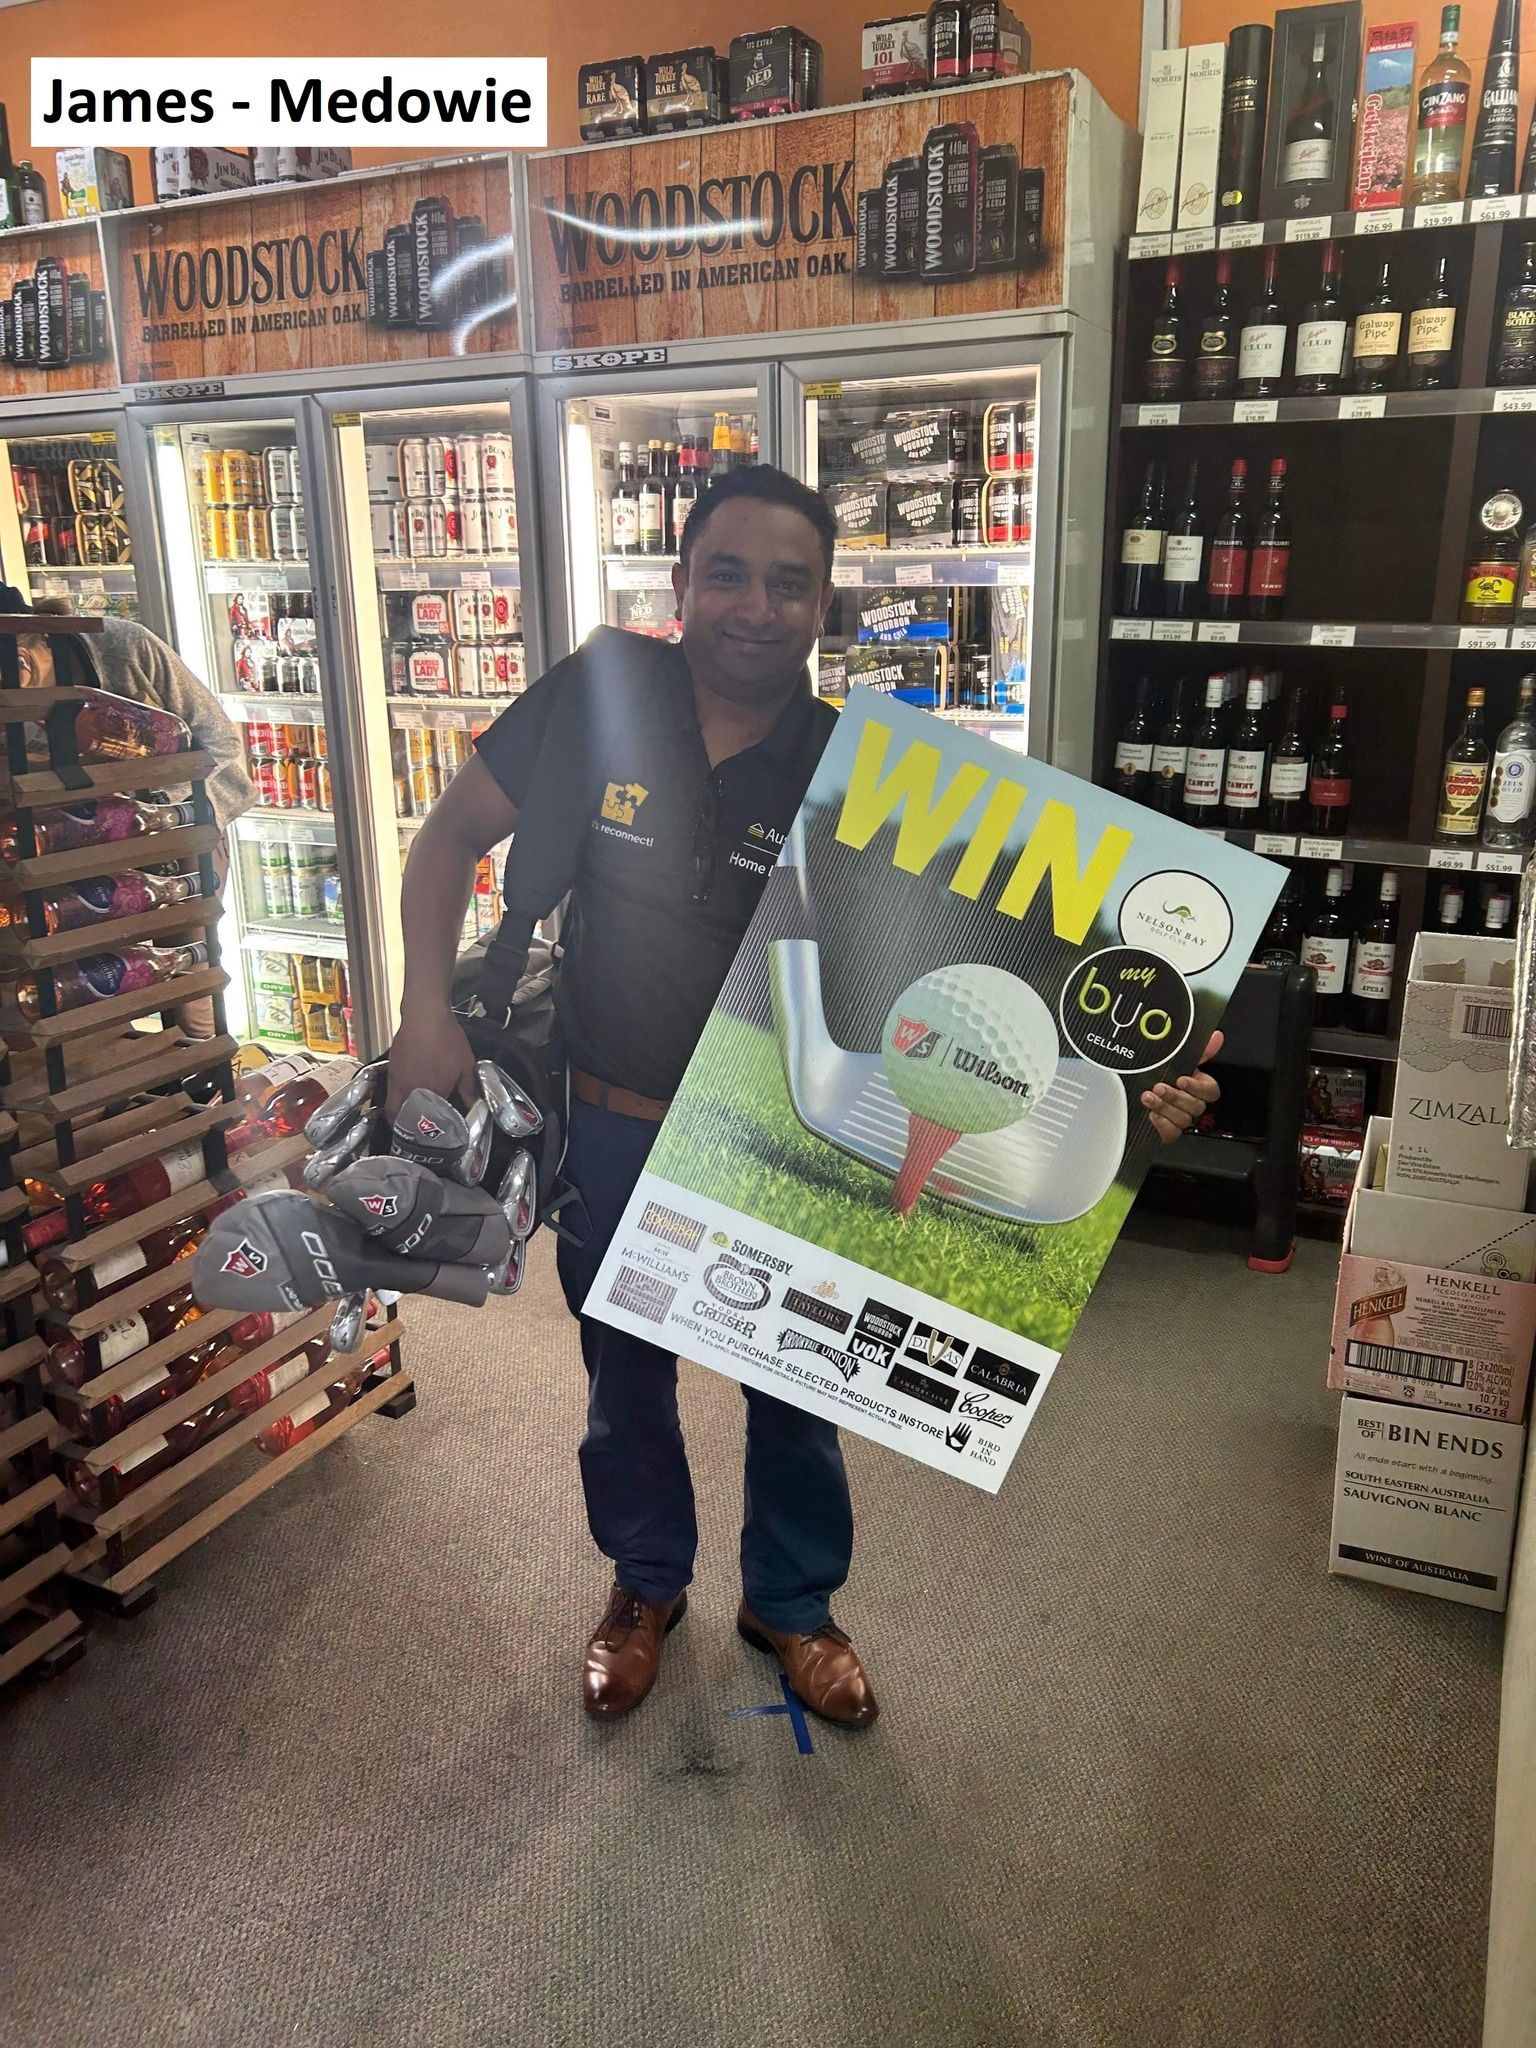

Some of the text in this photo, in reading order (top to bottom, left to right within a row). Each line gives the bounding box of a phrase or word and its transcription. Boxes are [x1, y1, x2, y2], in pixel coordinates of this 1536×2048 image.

[872, 41, 895, 51] TURKEY
[876, 33, 893, 42] WILD
[874, 51, 893, 65] 101
[746, 69, 772, 87] NED
[586, 93, 606, 104] RARE
[655, 84, 676, 96] RARE
[1422, 92, 1466, 109] CINZANO
[1358, 94, 1383, 190] Gekkeikan
[214, 162, 229, 179] JIM
[925, 142, 945, 270] WOODSTOCK
[1480, 210, 1511, 221] $61.99
[543, 160, 856, 277] WOODSTOCK
[884, 174, 899, 270] WOODSTOCK
[1364, 222, 1393, 233] $26.99
[1424, 216, 1453, 227] $19.99
[857, 196, 868, 268] WOODSTOCK
[133, 227, 367, 318] WOODSTOCK
[416, 212, 433, 319] WOODSTOCK
[386, 240, 399, 318] WOODSTOCK
[560, 252, 852, 304] BARRELLED IN AMERICAN OAK.
[14, 290, 24, 359] WOODSTOCK
[37, 269, 51, 360] WOODSTOCK
[142, 303, 366, 344] BARRELLED IN AMERICAN OAK.
[1412, 315, 1447, 327] Galway
[1360, 320, 1395, 332] Galway
[1365, 328, 1388, 341] Pipe
[1416, 324, 1439, 336] Pipe
[553, 349, 667, 371] SKOPE
[136, 383, 224, 400] SKOPE
[1503, 402, 1532, 411] $43.99
[894, 421, 941, 448] WOODSTOCK
[903, 436, 934, 453] BOURBON
[834, 493, 878, 518] WOODSTOCK
[896, 491, 943, 516] WOODSTOCK
[906, 506, 937, 521] BOURBON
[843, 508, 872, 523] BOURBON
[417, 609, 442, 620] LADY
[631, 604, 654, 619] NED
[860, 598, 918, 627] WOODSTOCK
[873, 616, 911, 633] BOURBON
[414, 666, 439, 677] LADY
[835, 717, 1135, 946] WIN
[729, 851, 766, 875] Home
[1437, 861, 1463, 869] $49.99
[1485, 864, 1512, 872] $51.99
[1135, 910, 1208, 947] NELSON BAY
[1150, 926, 1188, 947] GOLF CLUB
[1119, 966, 1157, 989] my
[1078, 966, 1173, 1043] byo
[1085, 1031, 1136, 1060] CELLARS
[1409, 1098, 1508, 1126] ZIMZAL
[714, 1274, 759, 1301] BROTHERS
[723, 1269, 757, 1291] BROWN
[1427, 1273, 1501, 1297] HENKELL
[1433, 1287, 1467, 1297] PICCOLO
[711, 1303, 745, 1320] VODKA
[1353, 1293, 1403, 1320] HENKELL
[692, 1300, 757, 1339] CRUISER
[863, 1312, 903, 1338] WOODSTOCK
[866, 1323, 894, 1340] BOURBON
[821, 1344, 855, 1376] UNION
[1468, 1360, 1515, 1377] 8 (3x200ml)
[671, 1311, 945, 1440] WHEN YOU PURCHASE SELECTED PRODUCTS INSTORE
[970, 1364, 1028, 1397] CALABRIA
[1467, 1370, 1484, 1381] 12.0%
[1466, 1381, 1484, 1392] 12.0%
[958, 1391, 1014, 1424] Coopers
[1467, 1403, 1508, 1418] 16218
[1479, 1394, 1510, 1409] 10.7 kg
[1357, 1418, 1382, 1429] BEST
[1361, 1429, 1377, 1439] OF
[978, 1437, 1001, 1453] BIRD
[981, 1447, 992, 1457] IN
[1388, 1424, 1504, 1460] BIN ENDS
[970, 1450, 996, 1467] HAND
[1354, 1451, 1366, 1461] All
[1367, 1454, 1390, 1465] ends
[1391, 1458, 1417, 1470] start
[1418, 1463, 1439, 1474] with
[1345, 1470, 1490, 1505] SOUTH EASTERN AUSTRALIA
[1343, 1486, 1482, 1523] SAUVIGNON BLANC
[1364, 1551, 1470, 1583] WINE OF AUSTRALIA
